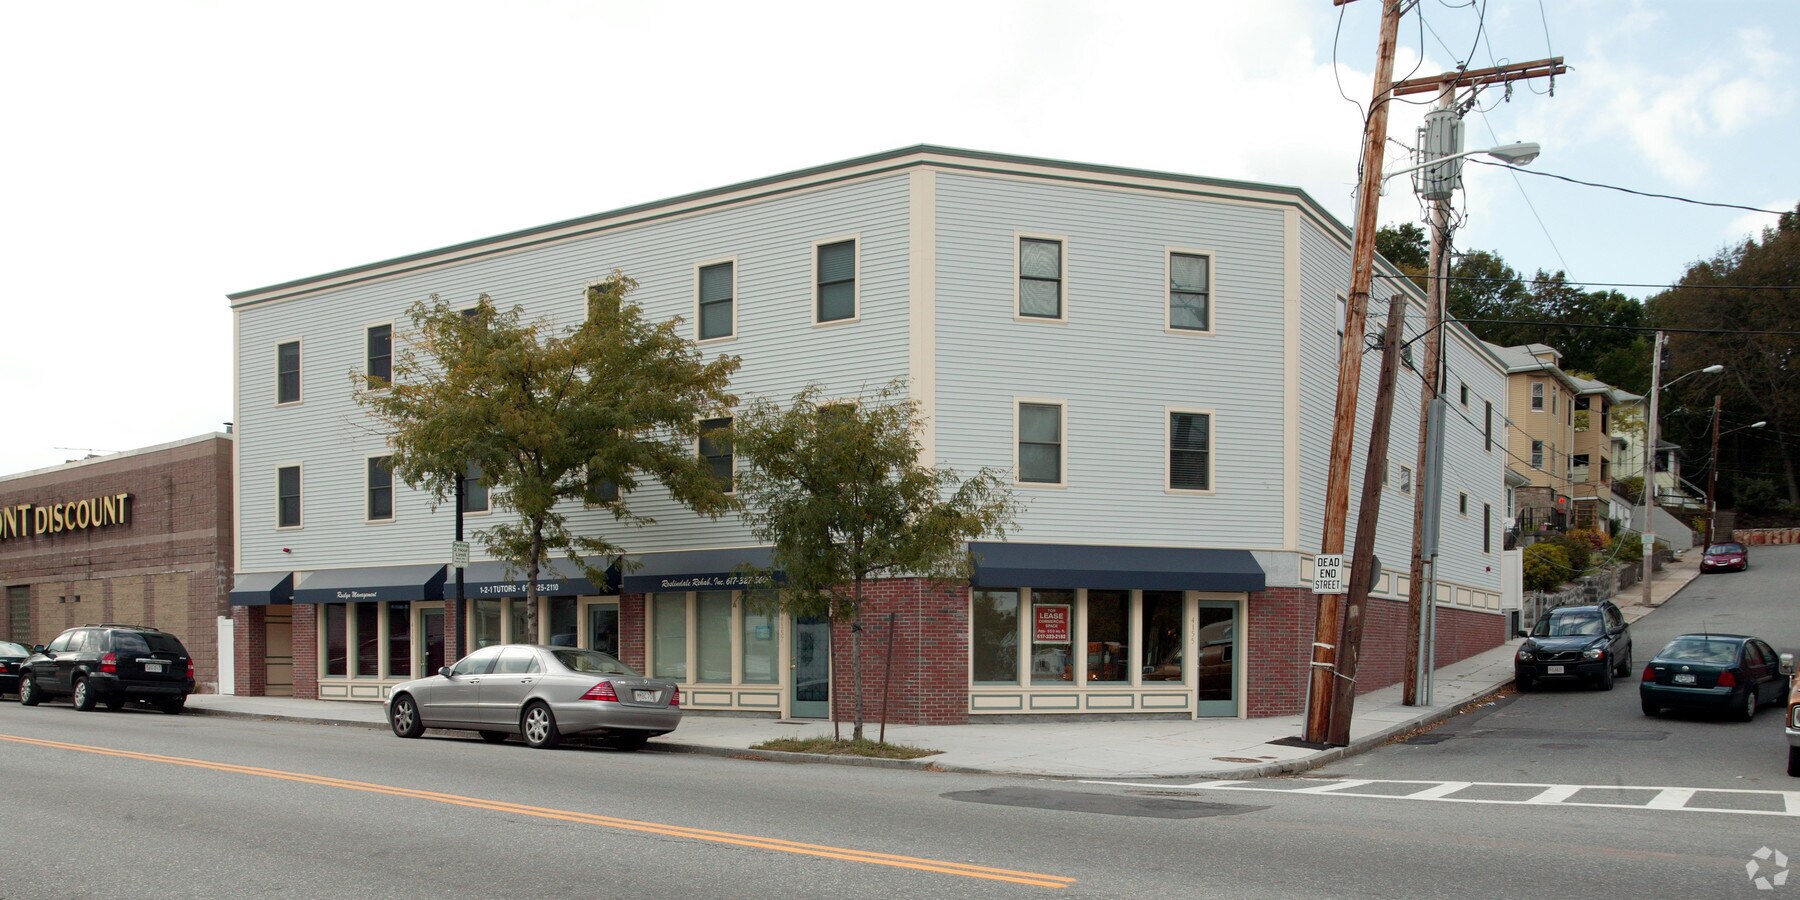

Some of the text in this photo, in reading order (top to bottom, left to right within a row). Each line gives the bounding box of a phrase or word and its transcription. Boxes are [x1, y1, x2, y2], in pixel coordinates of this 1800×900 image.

[0, 493, 128, 539] NT DISCOUNT
[1317, 557, 1340, 567] DEAD
[1320, 569, 1336, 578] END
[661, 579, 690, 588] Roslindale
[1315, 580, 1340, 590] STREET
[480, 586, 493, 594] 1-2-1
[493, 584, 517, 594] TUTORS
[351, 591, 377, 599] Management
